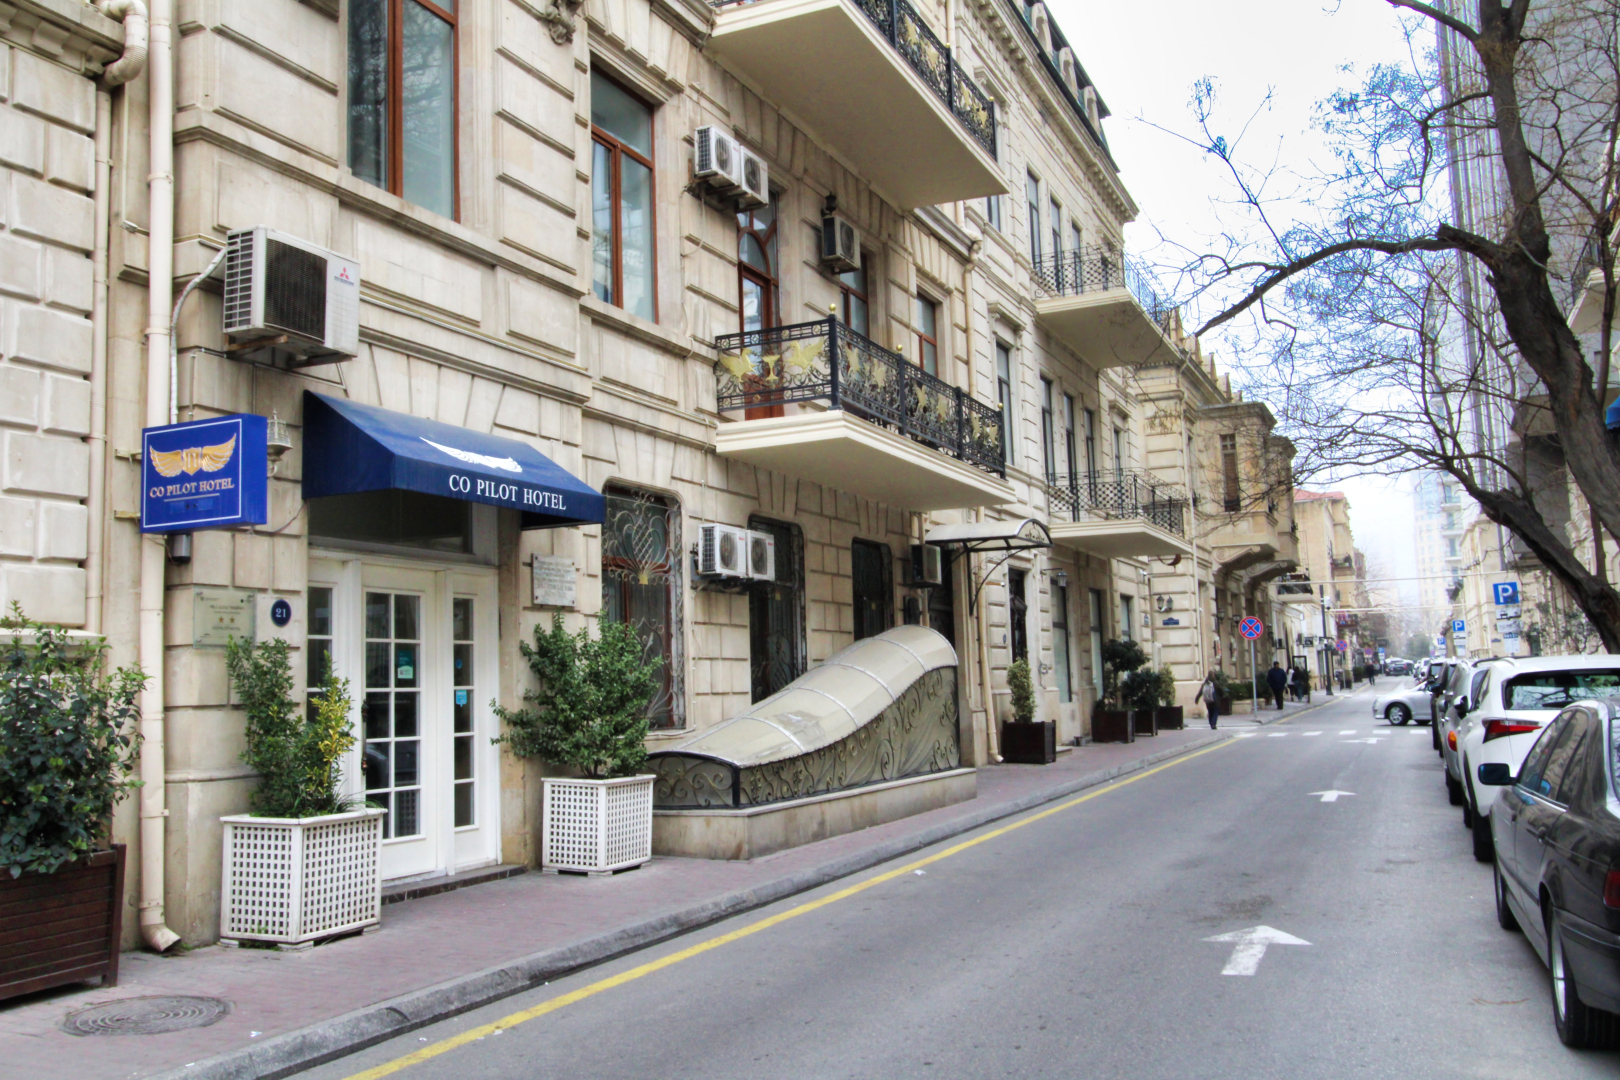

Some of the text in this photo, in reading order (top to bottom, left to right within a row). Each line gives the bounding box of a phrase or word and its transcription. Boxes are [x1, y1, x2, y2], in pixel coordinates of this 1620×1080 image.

[149, 477, 235, 498] CO PILOT HOTEL
[449, 474, 567, 510] CO PILOT HOTEL
[1497, 584, 1513, 603] P
[275, 608, 286, 618] 21
[1455, 621, 1463, 631] P
